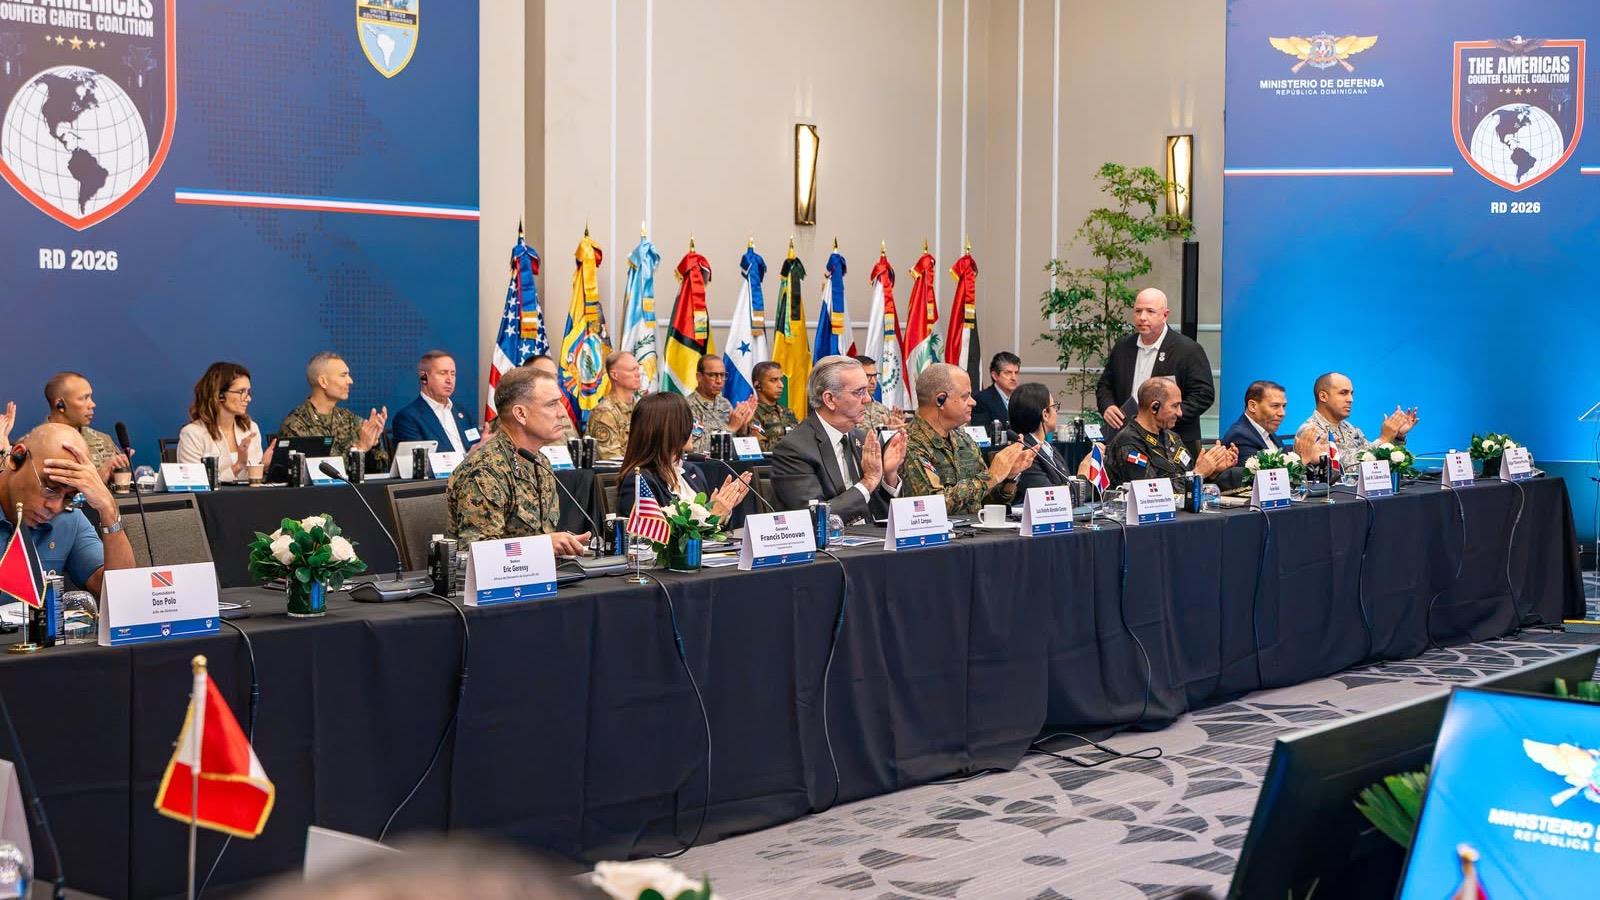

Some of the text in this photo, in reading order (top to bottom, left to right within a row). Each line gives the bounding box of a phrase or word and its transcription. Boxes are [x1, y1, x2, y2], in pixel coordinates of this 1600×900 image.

[0, 2, 154, 37] OUNTER CARTEL COALITION
[1468, 56, 1570, 74] THE AMERICAS
[1260, 78, 1384, 89] MINISTERIO DE DEFENSA
[1467, 73, 1570, 85] COUNTER CARTEL COALITION
[1490, 202, 1542, 214] RD 2026
[39, 248, 119, 271] RD 2026
[760, 531, 806, 542] Francis Donovan
[503, 565, 512, 573] Eric
[152, 597, 177, 606] Don Polo
[1488, 807, 1595, 840] MINISTERIO
